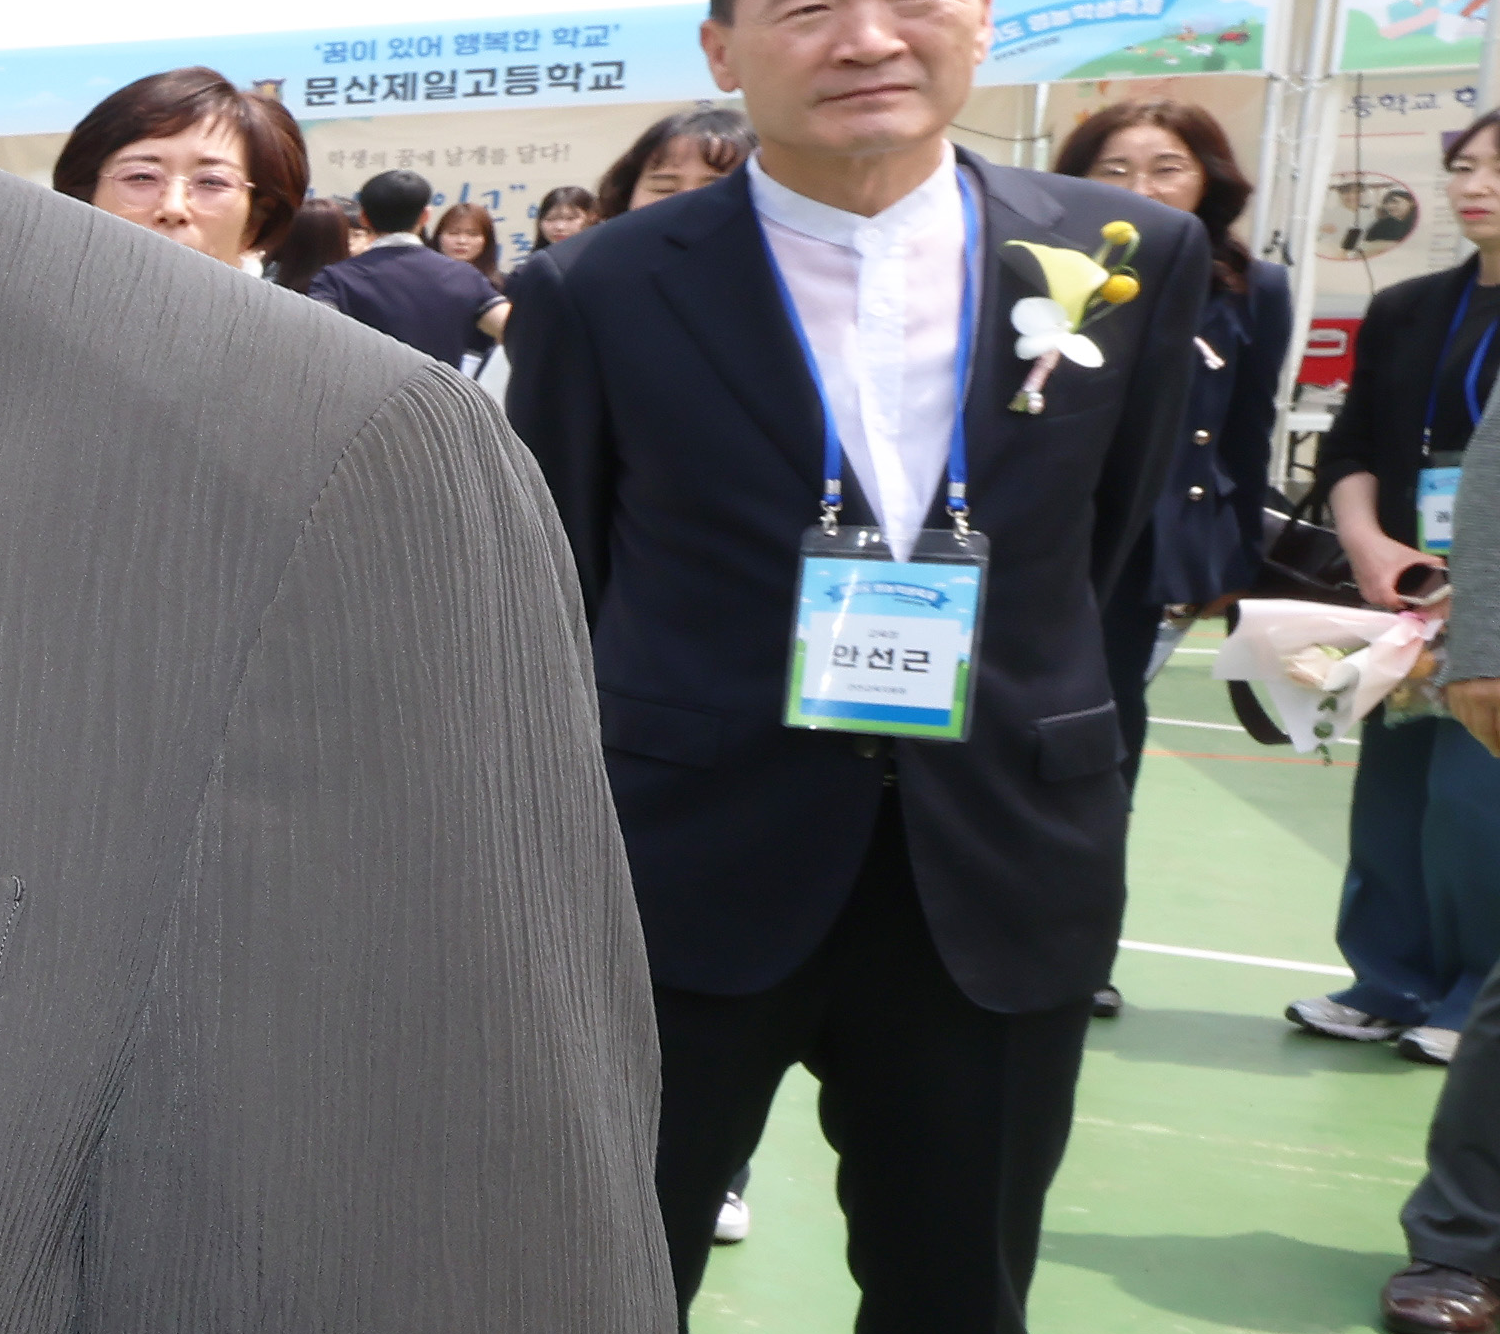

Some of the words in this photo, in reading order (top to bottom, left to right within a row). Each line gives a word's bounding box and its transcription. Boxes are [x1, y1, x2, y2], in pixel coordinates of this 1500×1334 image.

[388, 35, 444, 61] 있어
[453, 29, 541, 57] 행복한
[304, 60, 627, 107] 문산제일고등학교
[831, 644, 931, 673] 안선근
